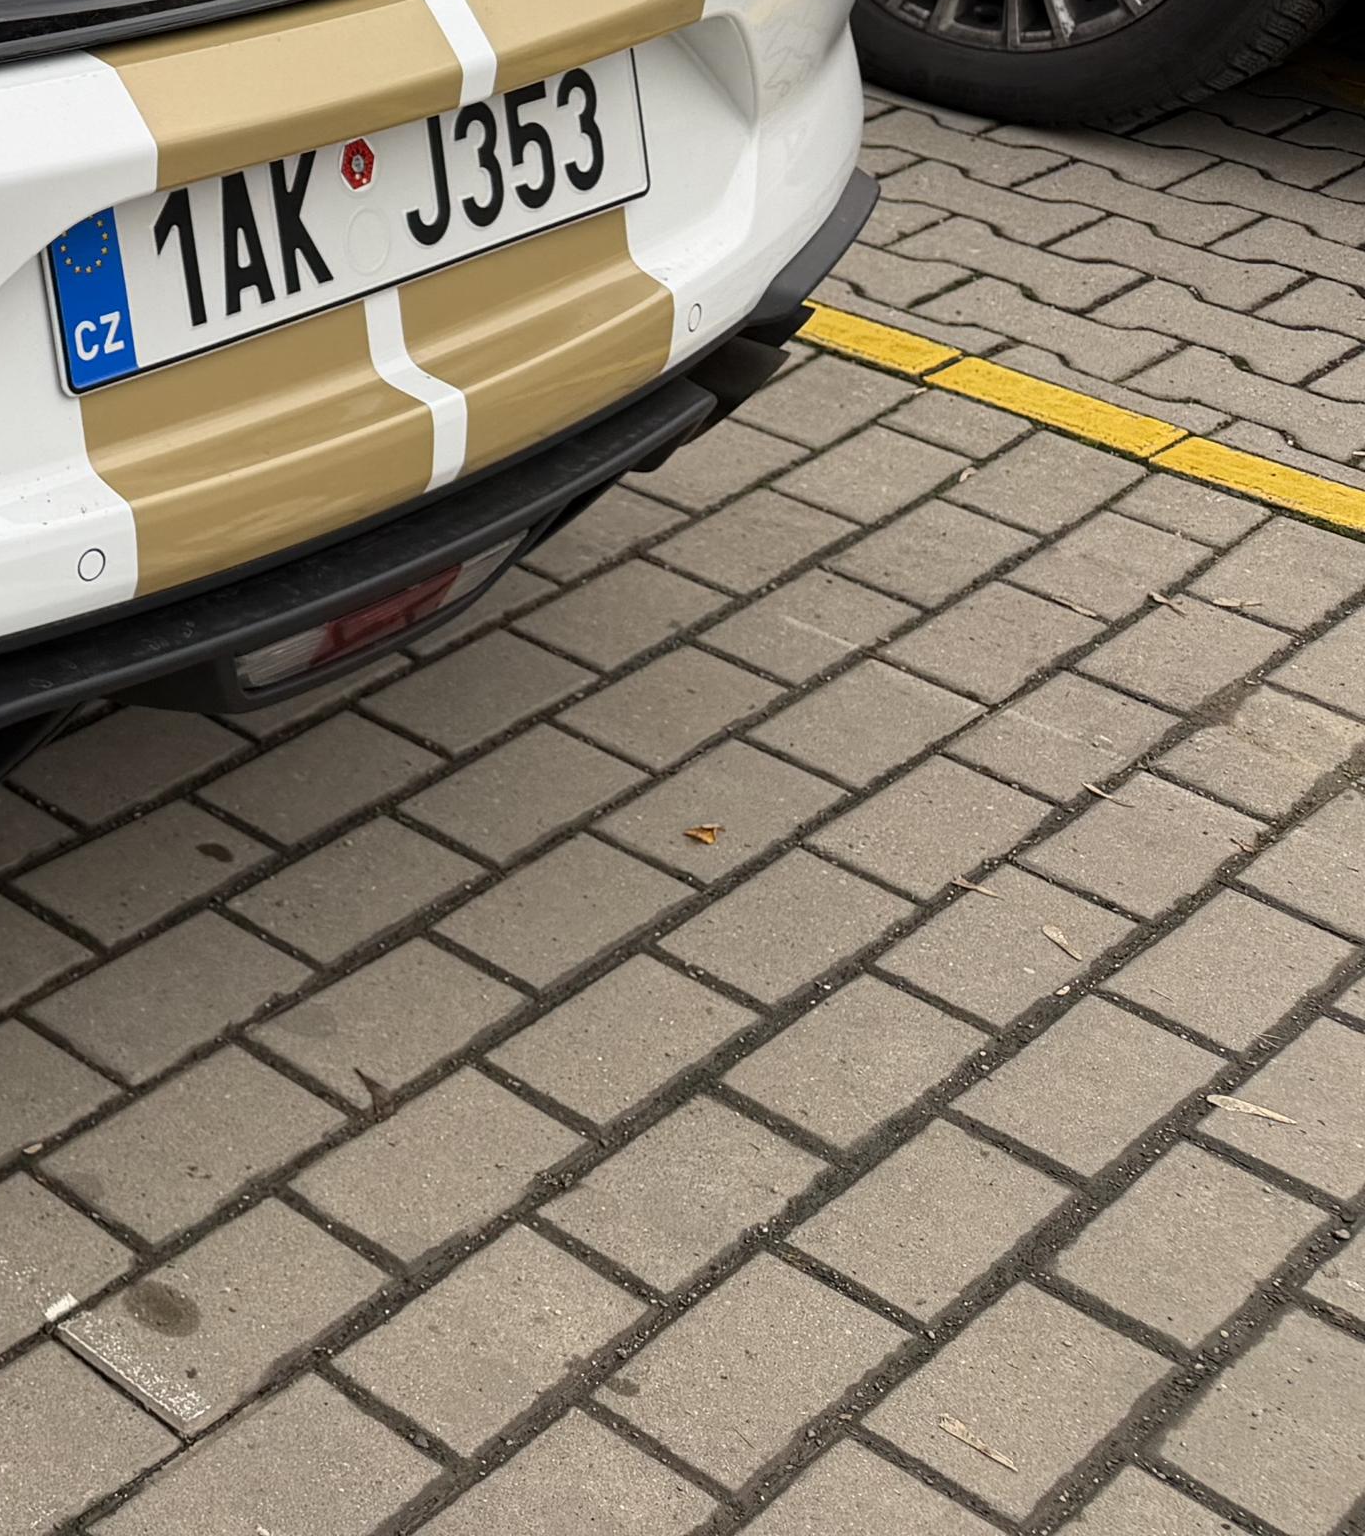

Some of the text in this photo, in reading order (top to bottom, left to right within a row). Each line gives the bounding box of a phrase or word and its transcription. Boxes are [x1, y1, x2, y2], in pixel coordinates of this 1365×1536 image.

[153, 67, 604, 328] 1AK J353
[73, 310, 126, 362] CZ
